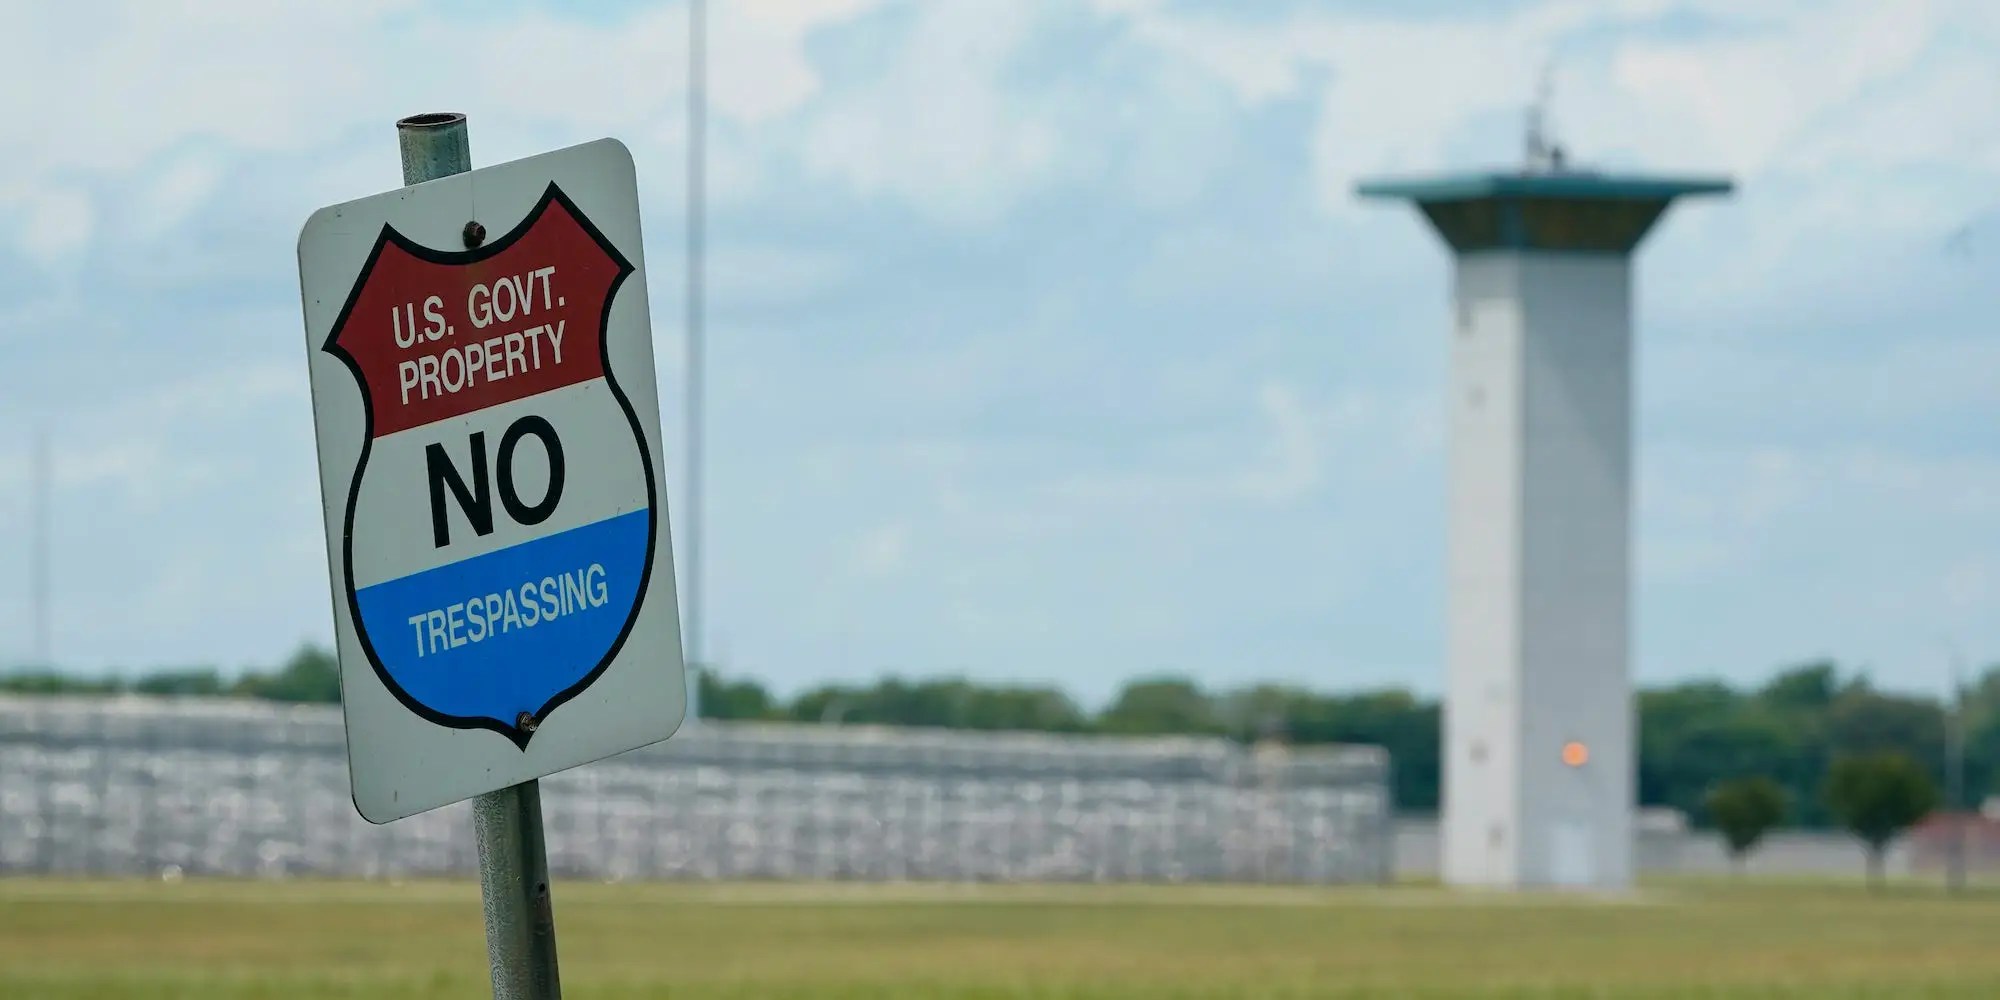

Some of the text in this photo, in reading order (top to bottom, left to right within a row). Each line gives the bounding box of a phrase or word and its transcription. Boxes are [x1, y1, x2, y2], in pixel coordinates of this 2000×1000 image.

[391, 265, 566, 349] U.S. GOVT.
[398, 319, 566, 405] PROPERTY
[425, 415, 566, 548] NO
[408, 563, 608, 658] TRESPASSING
